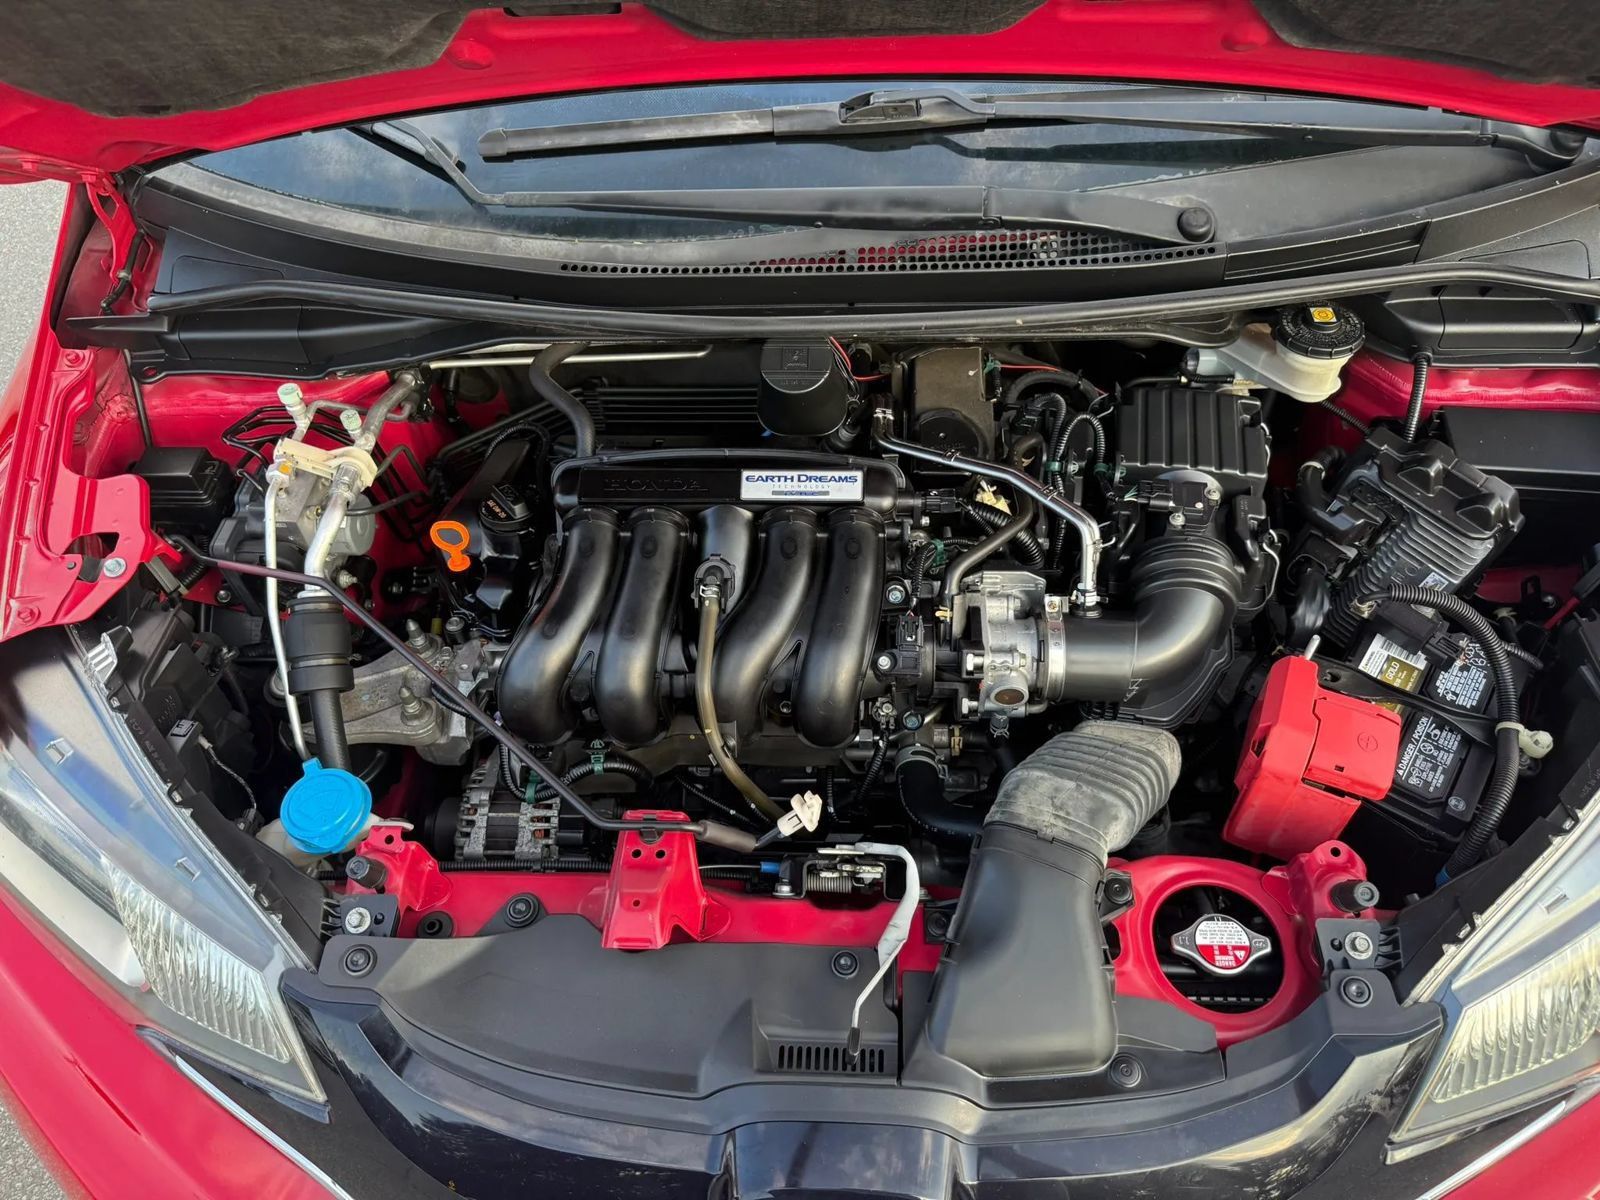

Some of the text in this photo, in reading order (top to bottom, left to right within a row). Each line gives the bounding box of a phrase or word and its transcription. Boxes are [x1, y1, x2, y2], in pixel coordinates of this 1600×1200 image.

[603, 479, 709, 491] HONDA
[745, 473, 858, 483] EARTH DREAMS
[1385, 660, 1400, 681] GOLD
[1398, 743, 1416, 771] DANGER
[1412, 716, 1429, 739] POISON
